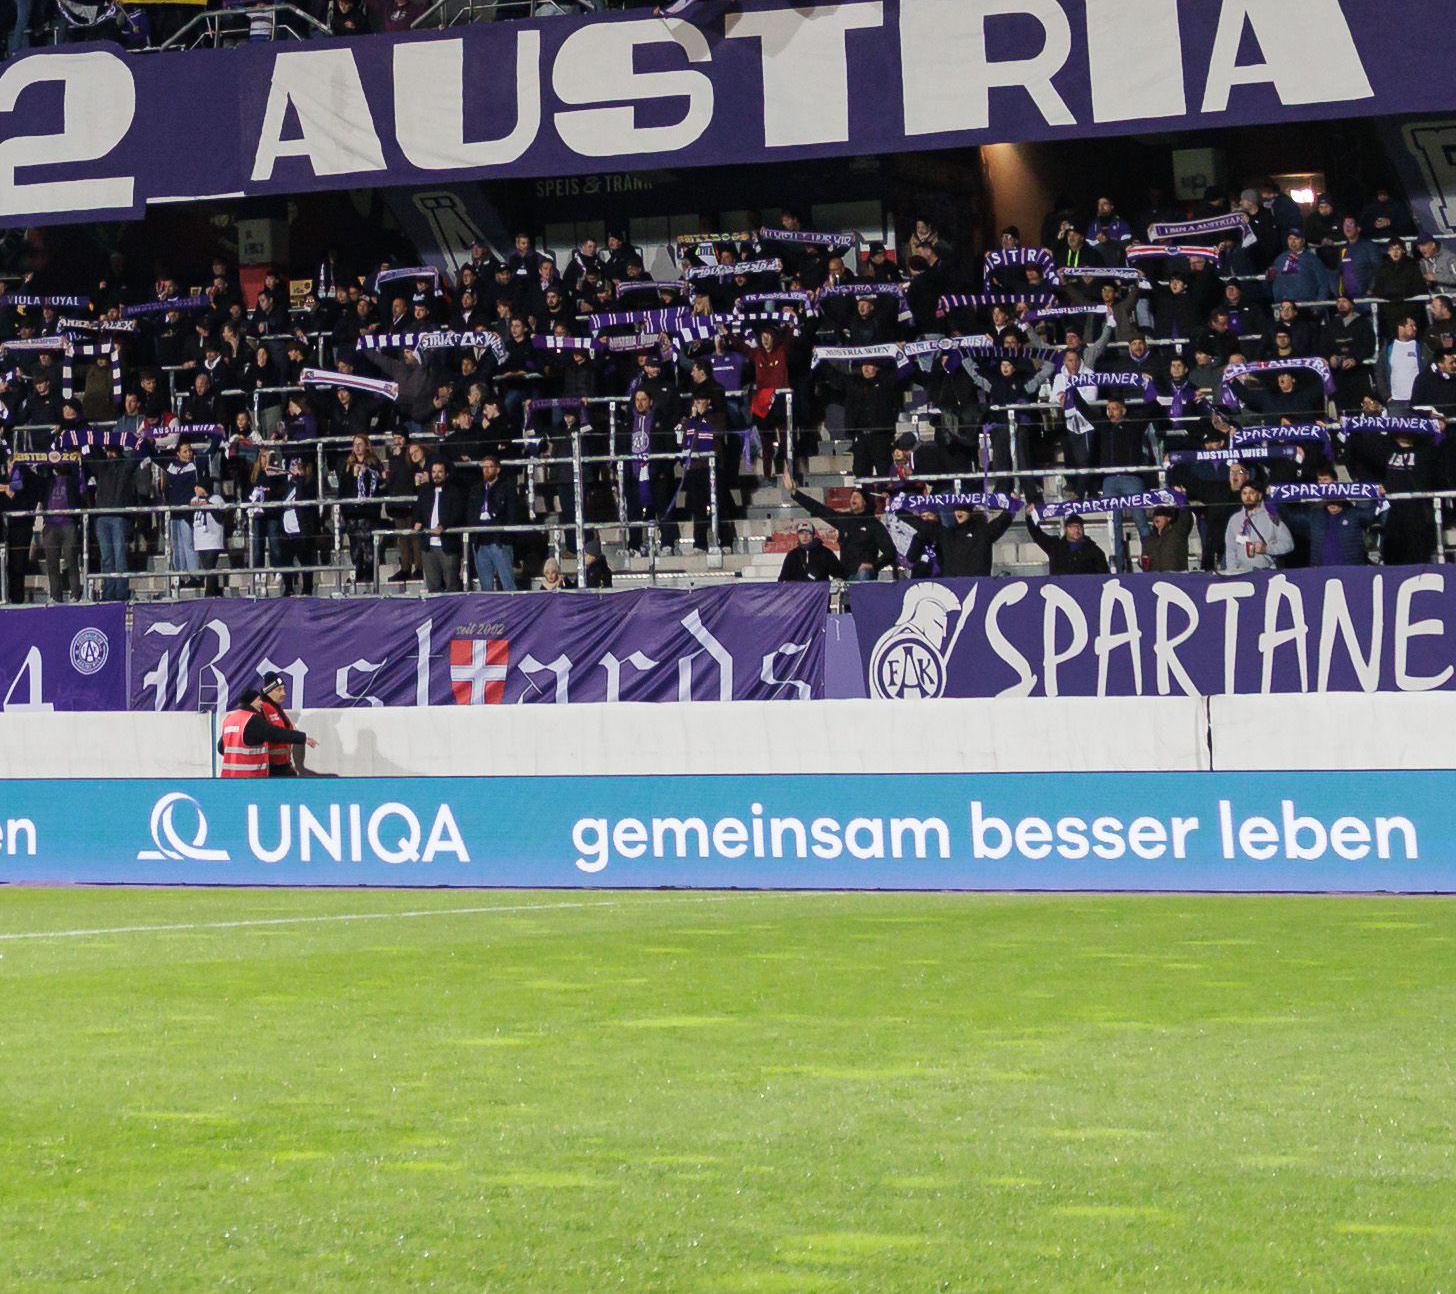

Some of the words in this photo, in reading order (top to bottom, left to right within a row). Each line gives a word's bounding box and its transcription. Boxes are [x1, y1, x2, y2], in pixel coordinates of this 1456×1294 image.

[536, 178, 580, 197] SPEIS
[1065, 370, 1142, 389] SPARTANER
[1233, 424, 1321, 443] SPARTANER
[1349, 415, 1431, 433] SPARTANER
[1195, 449, 1237, 461] AUSTRIA
[1238, 447, 1269, 459] WIEN
[905, 491, 991, 508] SPARTANER
[1283, 483, 1376, 500] SPARTANER
[1061, 491, 1155, 514] SPARTANER
[248, 803, 471, 865] UNIQA
[572, 801, 950, 874] gemeinsam
[971, 800, 1199, 861] besser
[1219, 798, 1419, 861] leben
